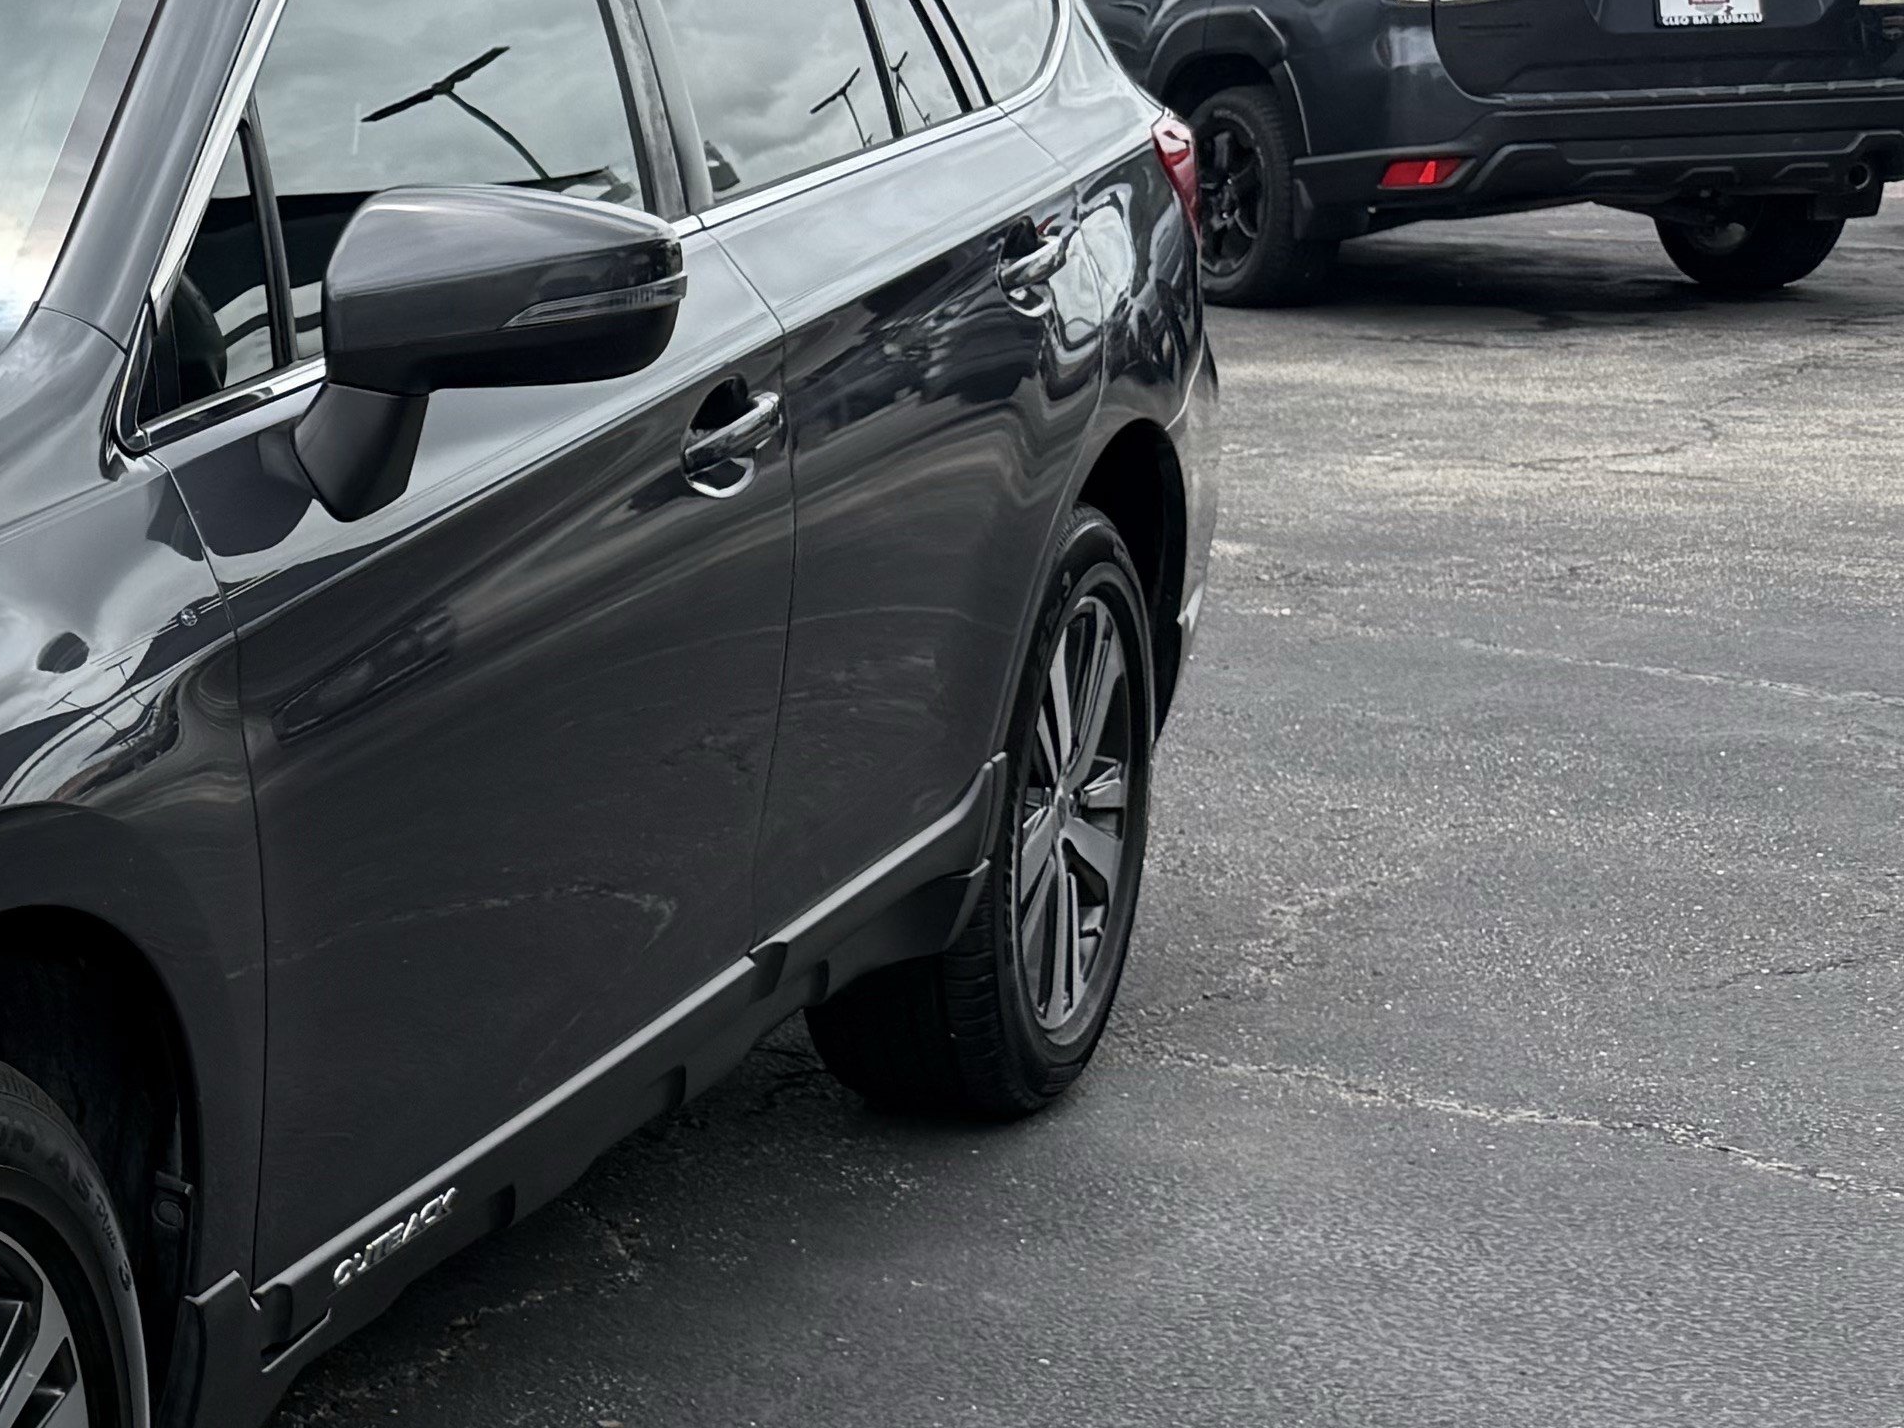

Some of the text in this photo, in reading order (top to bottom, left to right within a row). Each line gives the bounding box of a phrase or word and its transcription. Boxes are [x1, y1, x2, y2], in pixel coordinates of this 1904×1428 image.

[1662, 13, 1763, 26] CLEO BAY SUBARU
